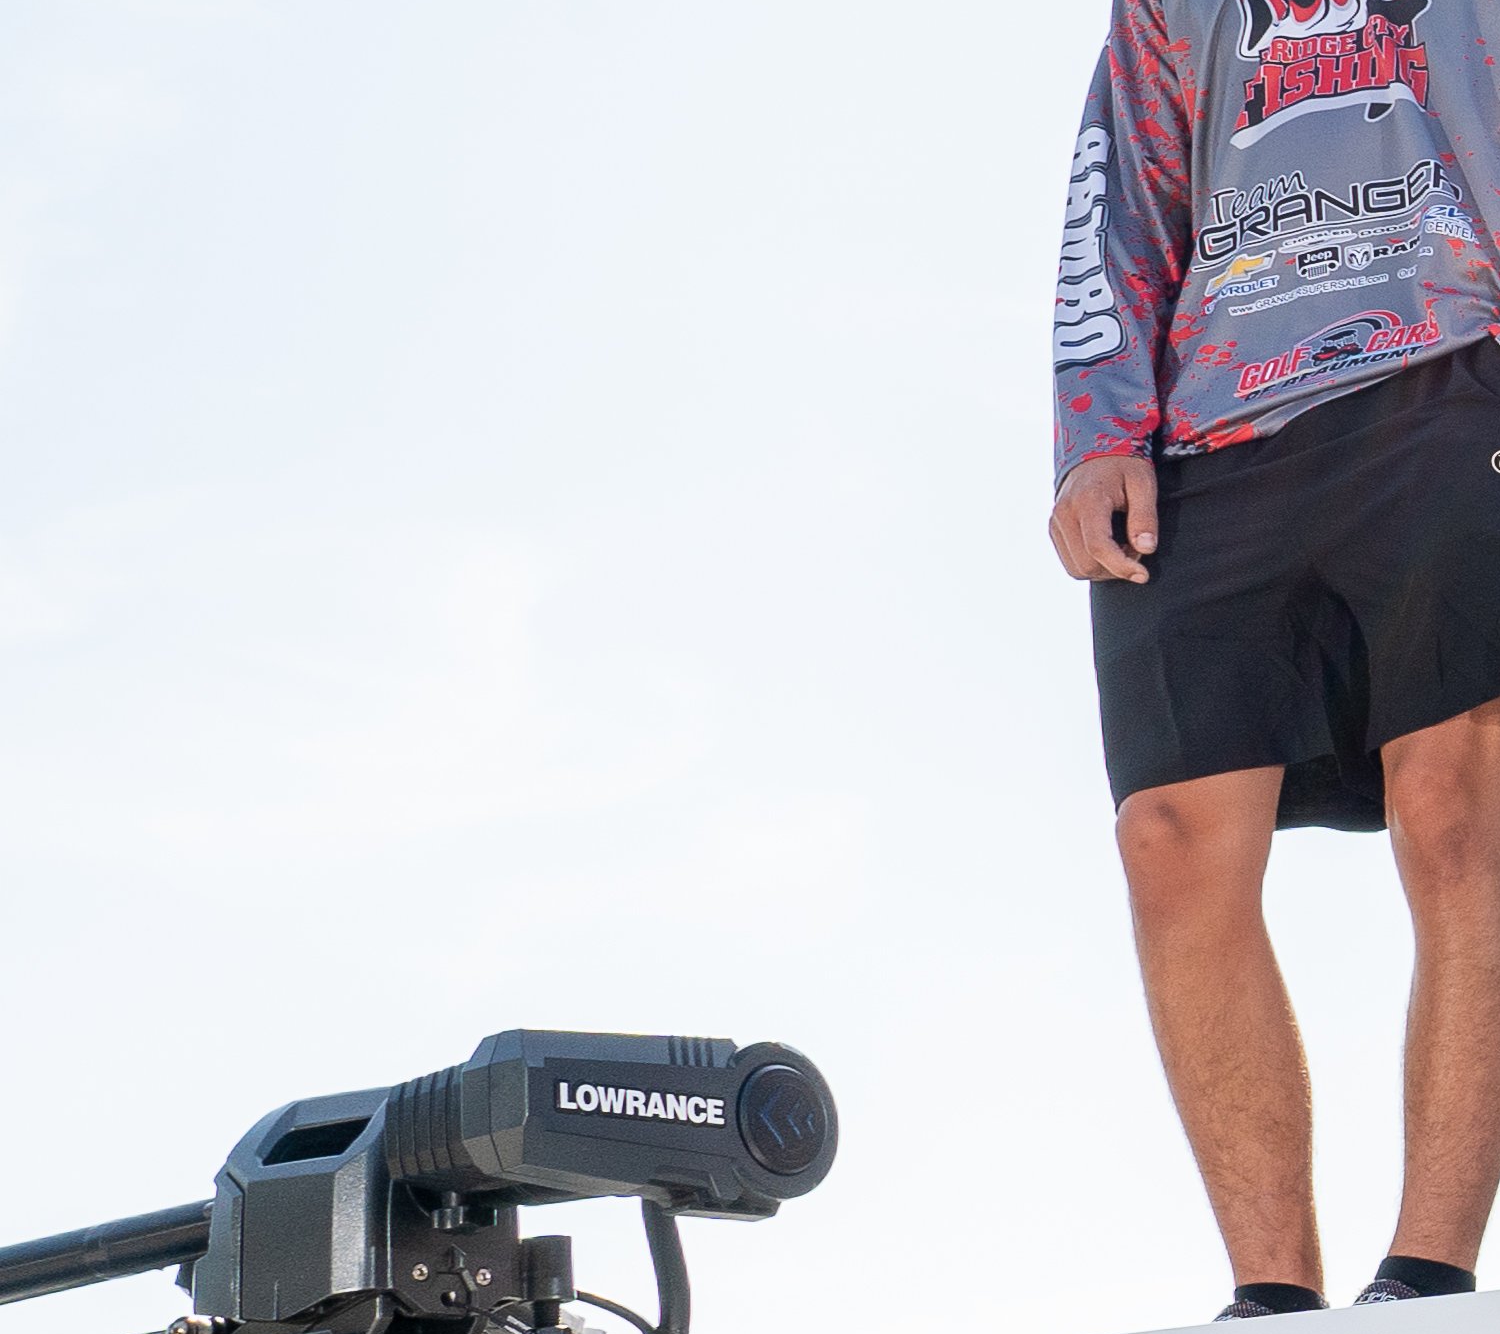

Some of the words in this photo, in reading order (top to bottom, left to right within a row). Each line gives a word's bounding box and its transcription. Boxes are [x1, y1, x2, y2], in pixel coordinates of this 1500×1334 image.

[1198, 159, 1462, 264] GRANGER
[1210, 170, 1306, 224] Team
[1303, 249, 1333, 265] Jeep
[1236, 346, 1312, 393] GOLF
[1366, 310, 1441, 354] CARS
[558, 1081, 726, 1127] LOWRANCE
